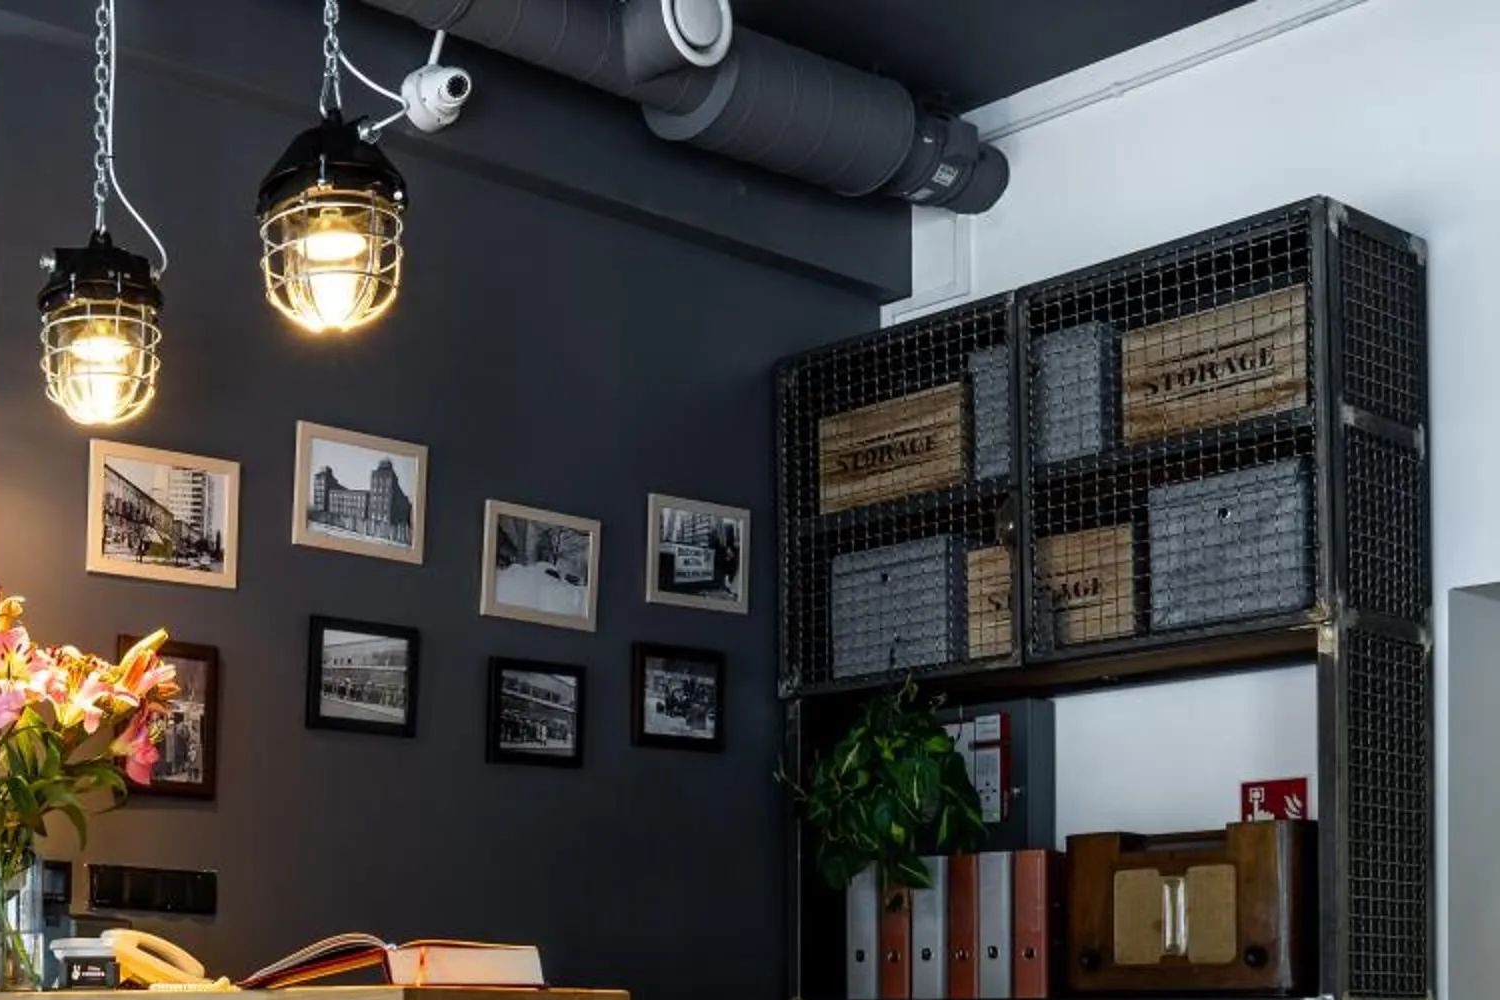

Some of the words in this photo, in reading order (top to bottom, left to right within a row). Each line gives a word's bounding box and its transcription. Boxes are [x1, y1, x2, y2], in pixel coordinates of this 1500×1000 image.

[1142, 346, 1275, 395] STORAGE
[835, 434, 938, 472] STORAGE
[987, 576, 1102, 612] SAGE
